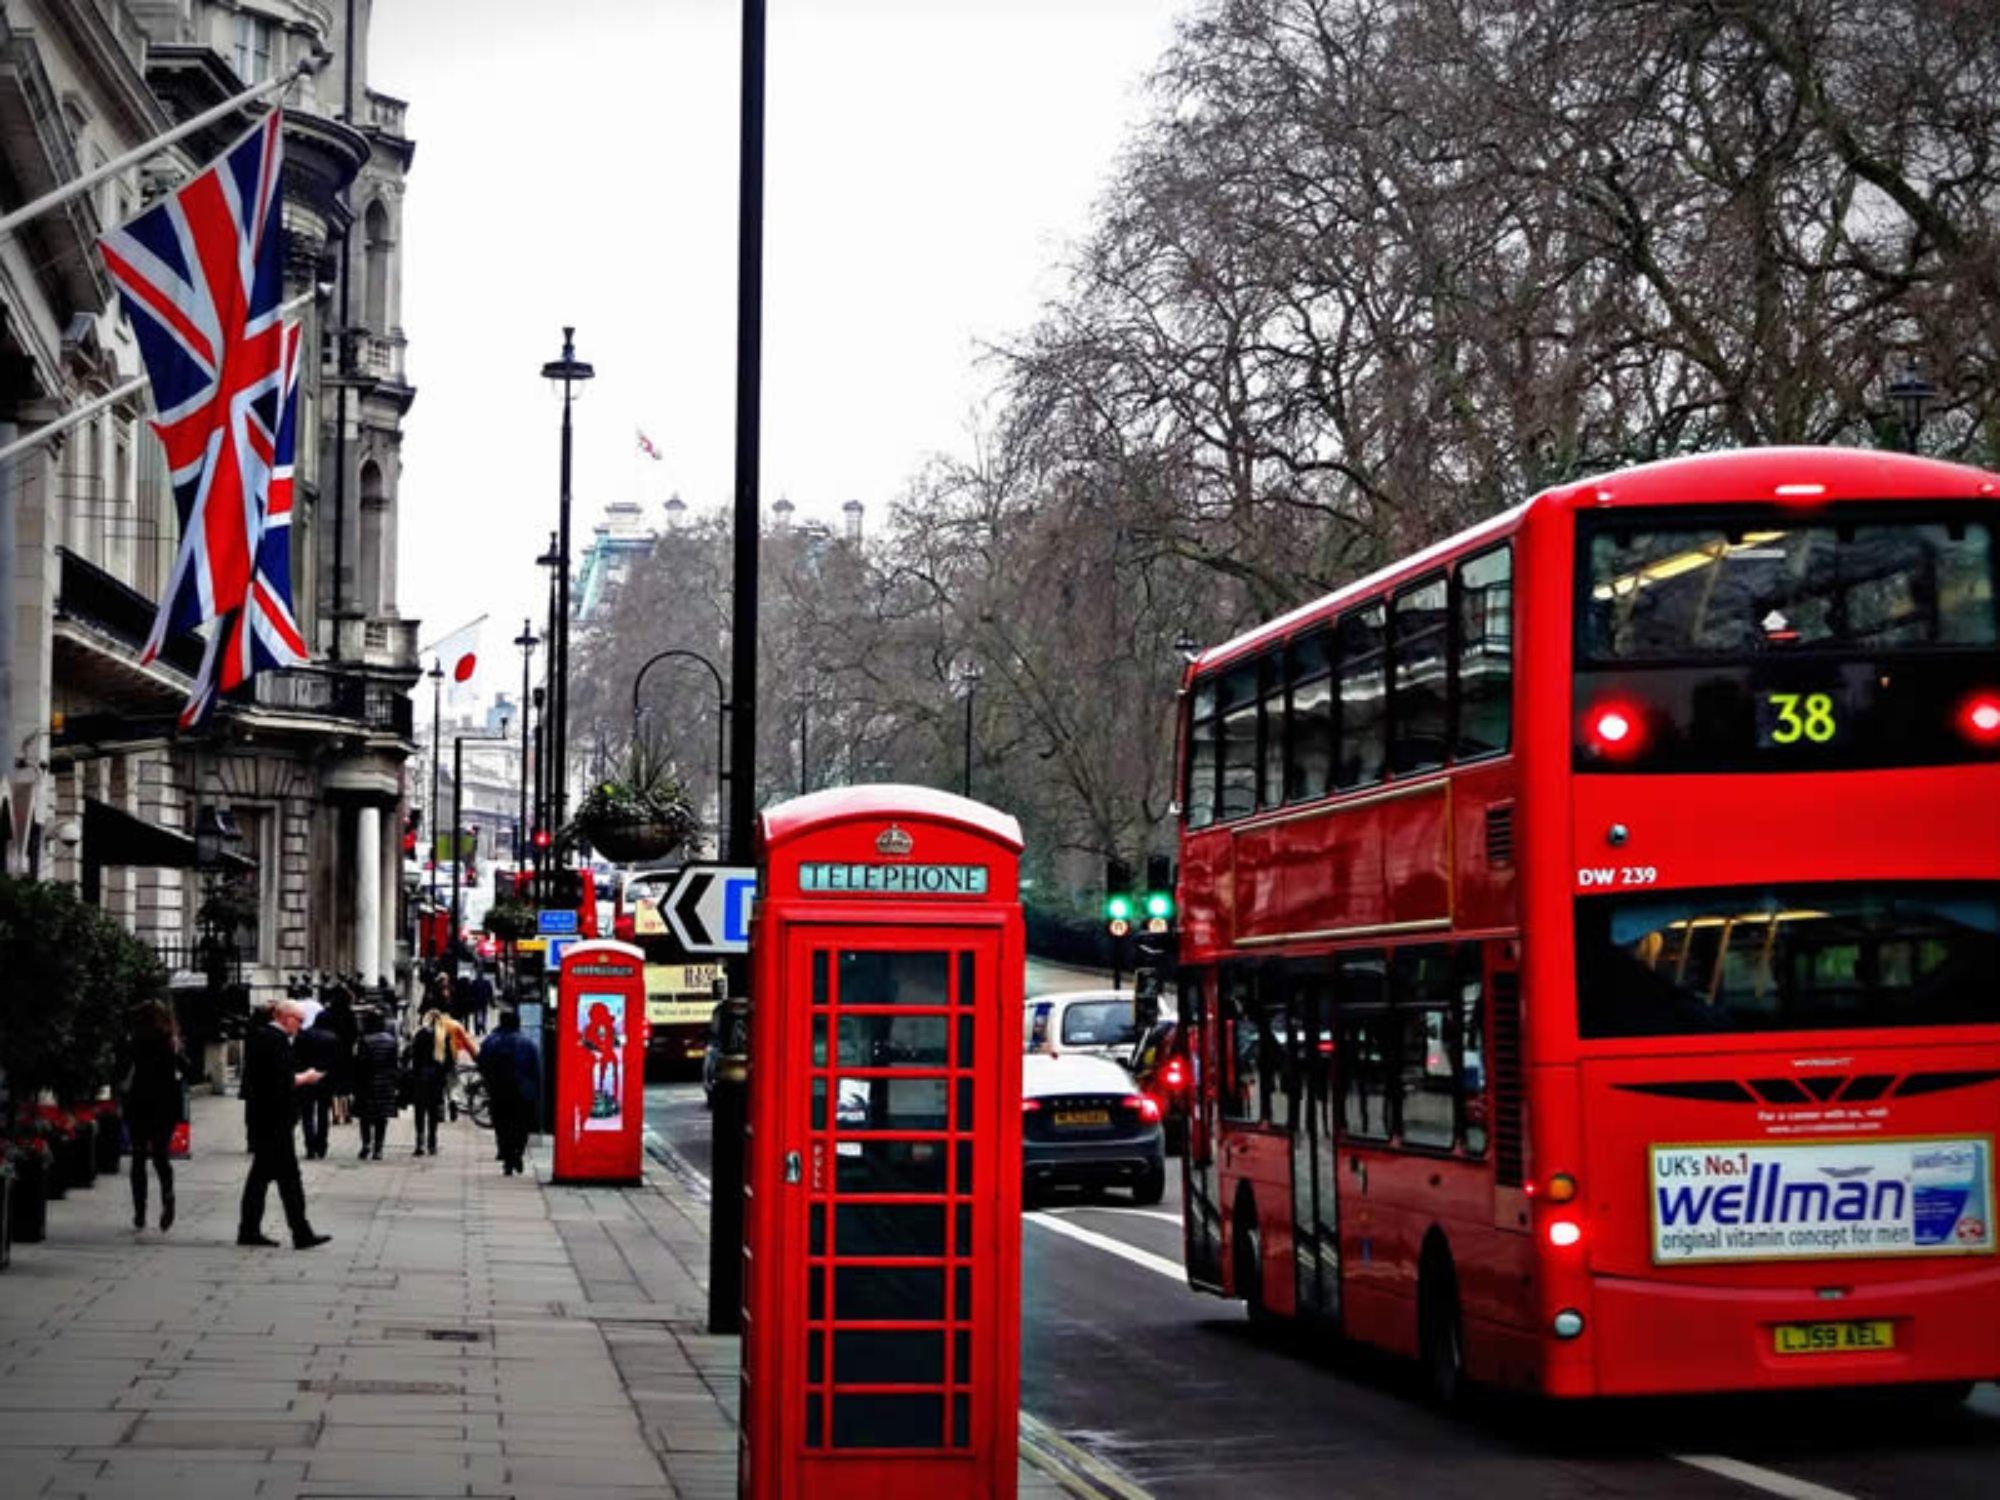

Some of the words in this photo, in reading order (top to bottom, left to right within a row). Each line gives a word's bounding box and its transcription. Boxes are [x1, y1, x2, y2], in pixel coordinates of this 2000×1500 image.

[1769, 693, 1836, 742] 38
[808, 864, 980, 891] TELEPHONE
[1578, 868, 1616, 886] DW
[1621, 866, 1656, 884] 239
[1657, 1155, 1701, 1178] UK's
[1704, 1152, 1748, 1176] No.1
[1657, 1162, 1906, 1226] wellman
[1661, 1228, 1722, 1255] original
[1727, 1226, 1785, 1248] vitamin
[1789, 1226, 1847, 1249] concept
[1851, 1223, 1872, 1243] for
[1875, 1226, 1910, 1243] men
[1782, 1326, 1837, 1350] LJ59
[1845, 1322, 1884, 1346] AEL
